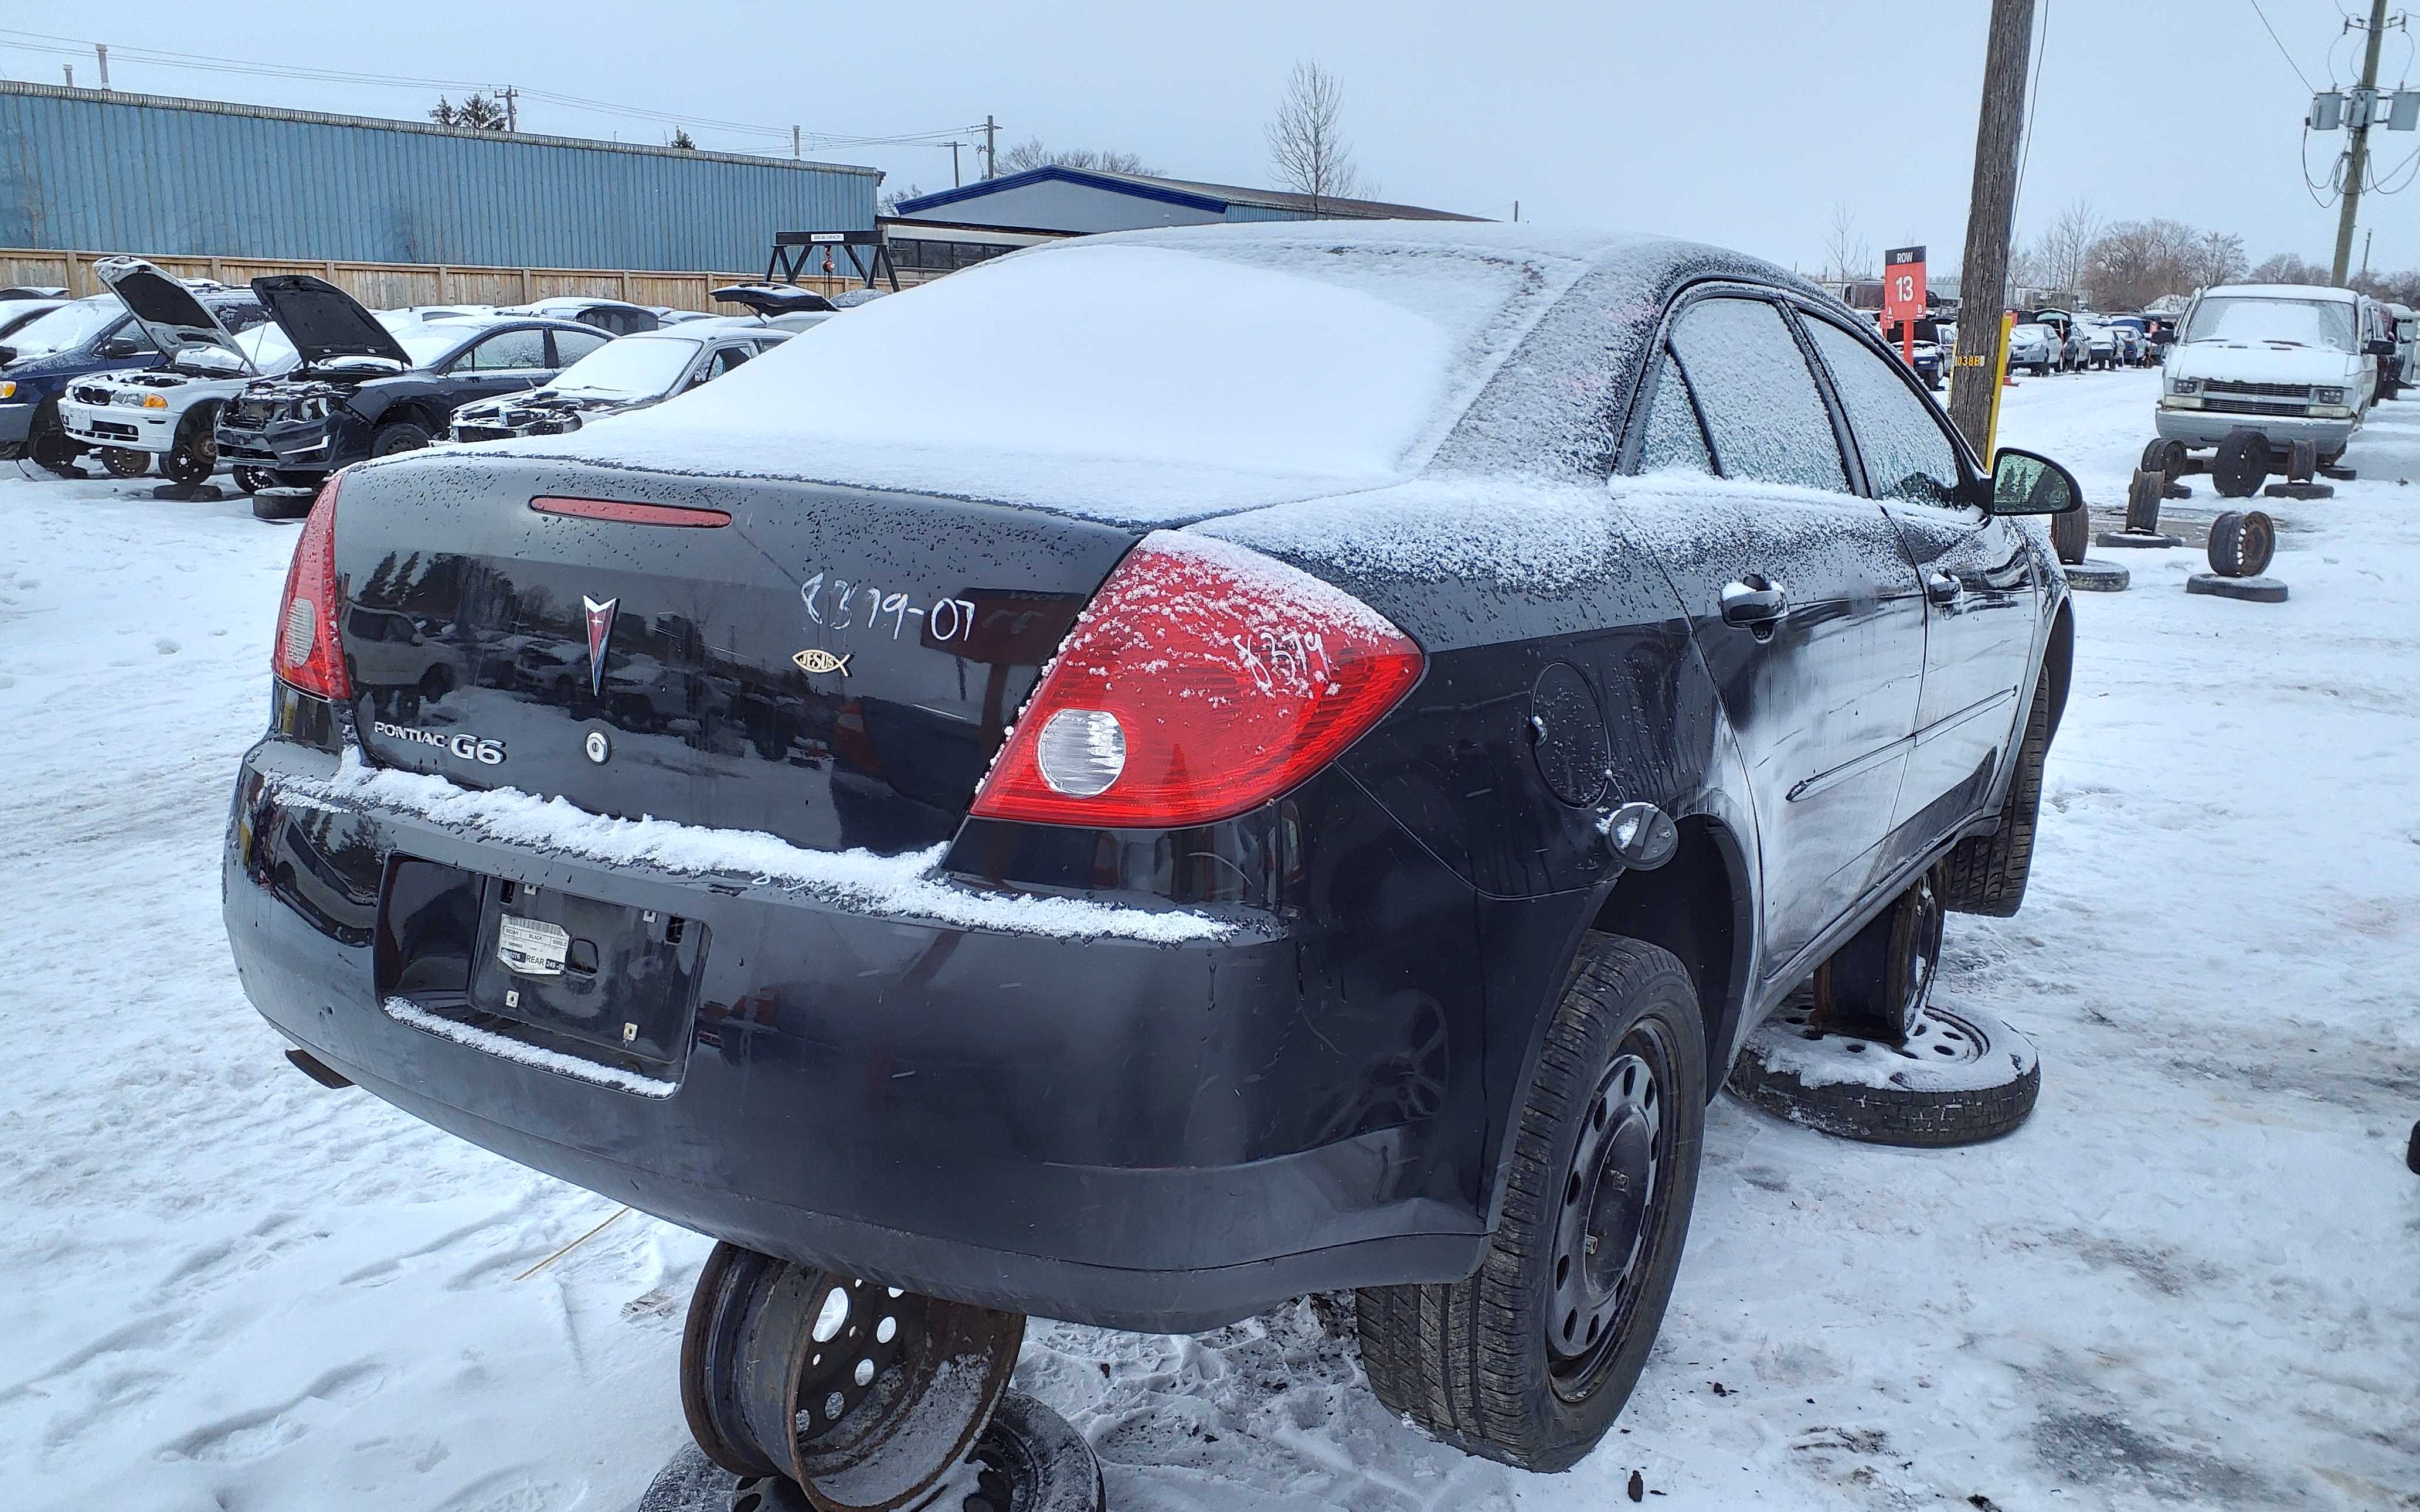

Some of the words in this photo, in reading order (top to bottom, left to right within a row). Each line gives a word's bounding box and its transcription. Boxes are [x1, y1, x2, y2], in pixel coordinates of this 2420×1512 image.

[1896, 251, 1913, 264] ROW
[1895, 275, 1914, 302] 13
[1888, 306, 1892, 315] A
[1918, 304, 1922, 314] B
[800, 652, 834, 670] JESUS
[374, 721, 447, 748] PONTIAC
[451, 733, 506, 765] G6
[526, 955, 545, 966] REAR
